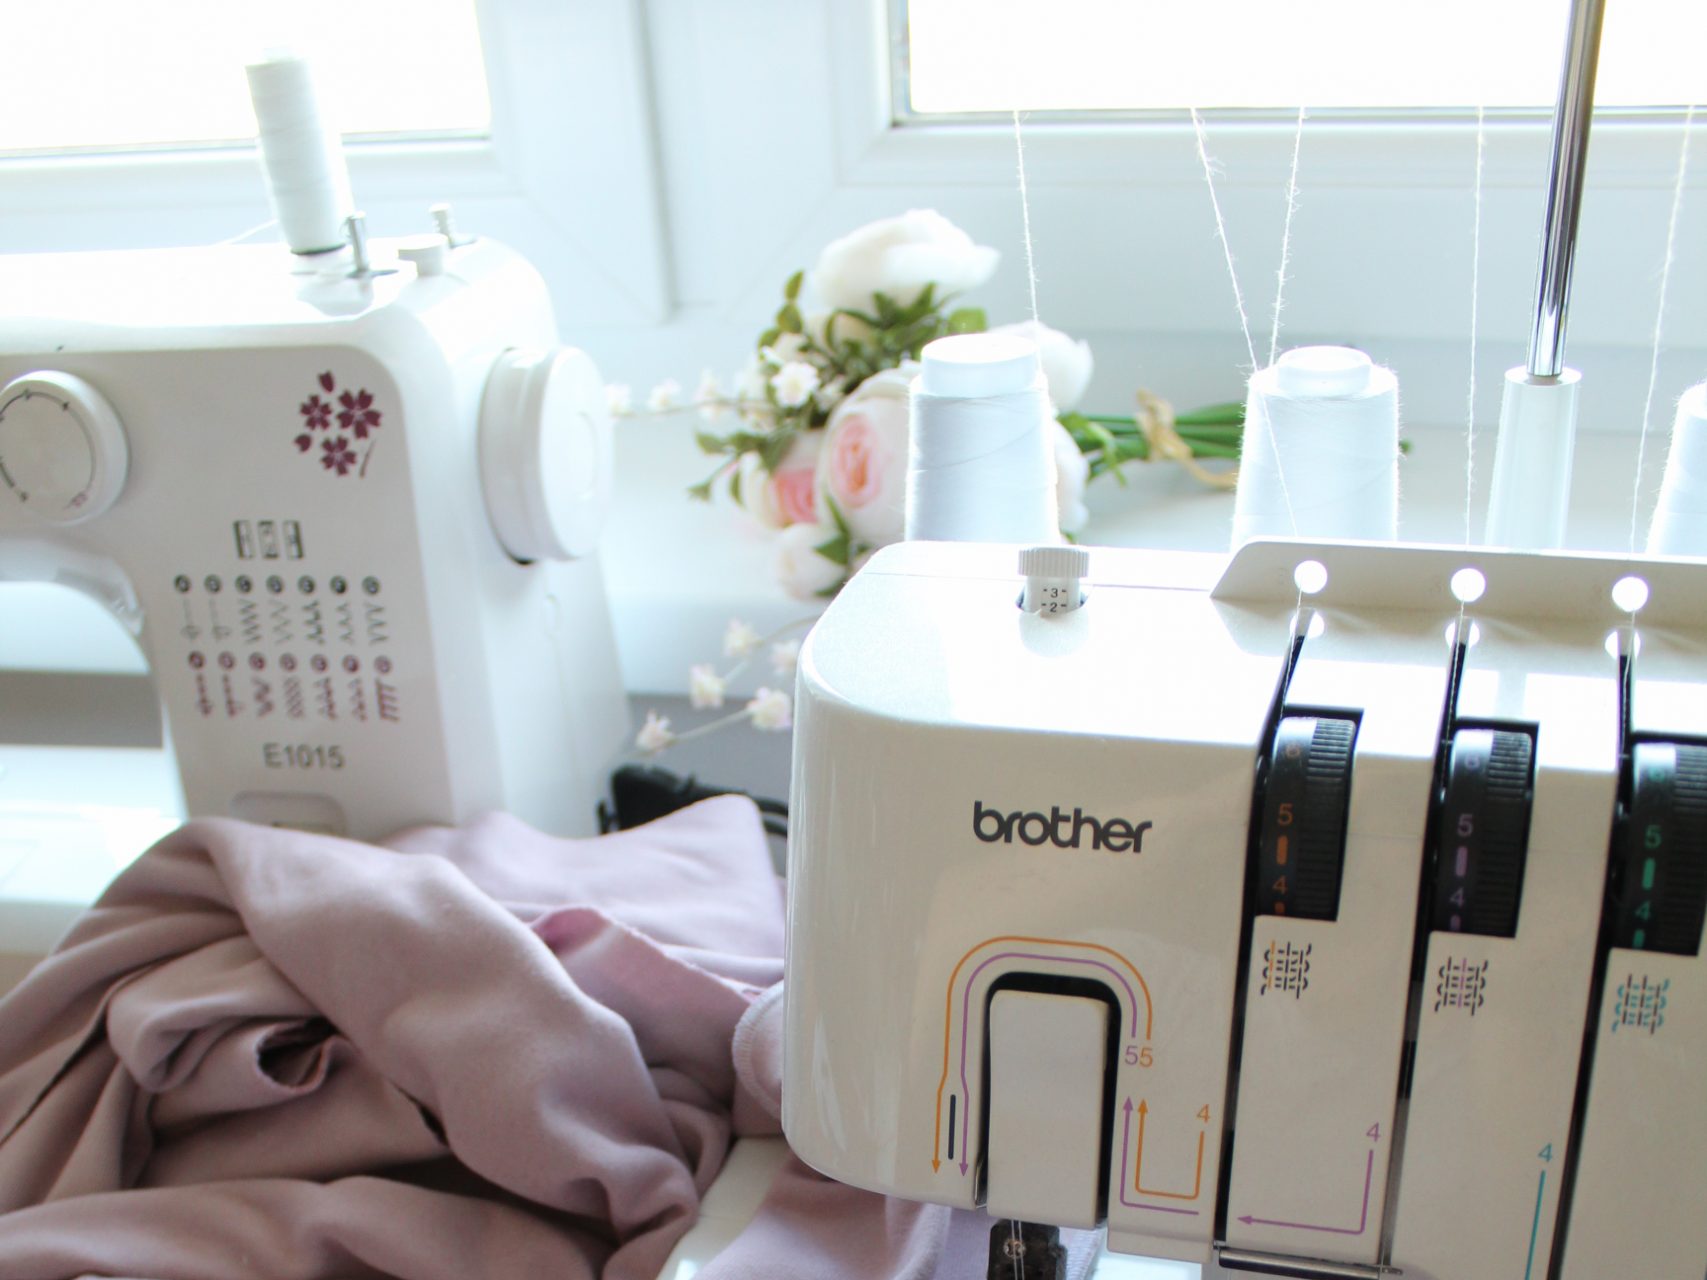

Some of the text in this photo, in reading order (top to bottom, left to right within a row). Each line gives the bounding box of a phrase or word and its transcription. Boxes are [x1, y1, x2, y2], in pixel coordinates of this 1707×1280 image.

[1050, 588, 1058, 598] 3
[1049, 602, 1058, 613] 2
[263, 743, 346, 769] E1015
[1277, 803, 1293, 825] 5
[973, 800, 1152, 853] brother
[1457, 814, 1474, 836] 5
[1645, 825, 1661, 848] 5
[1272, 877, 1288, 894] 4
[1451, 888, 1465, 906] 4
[1197, 1104, 1210, 1123] 4
[1366, 1122, 1380, 1142] 4
[1538, 1142, 1553, 1162] 4
